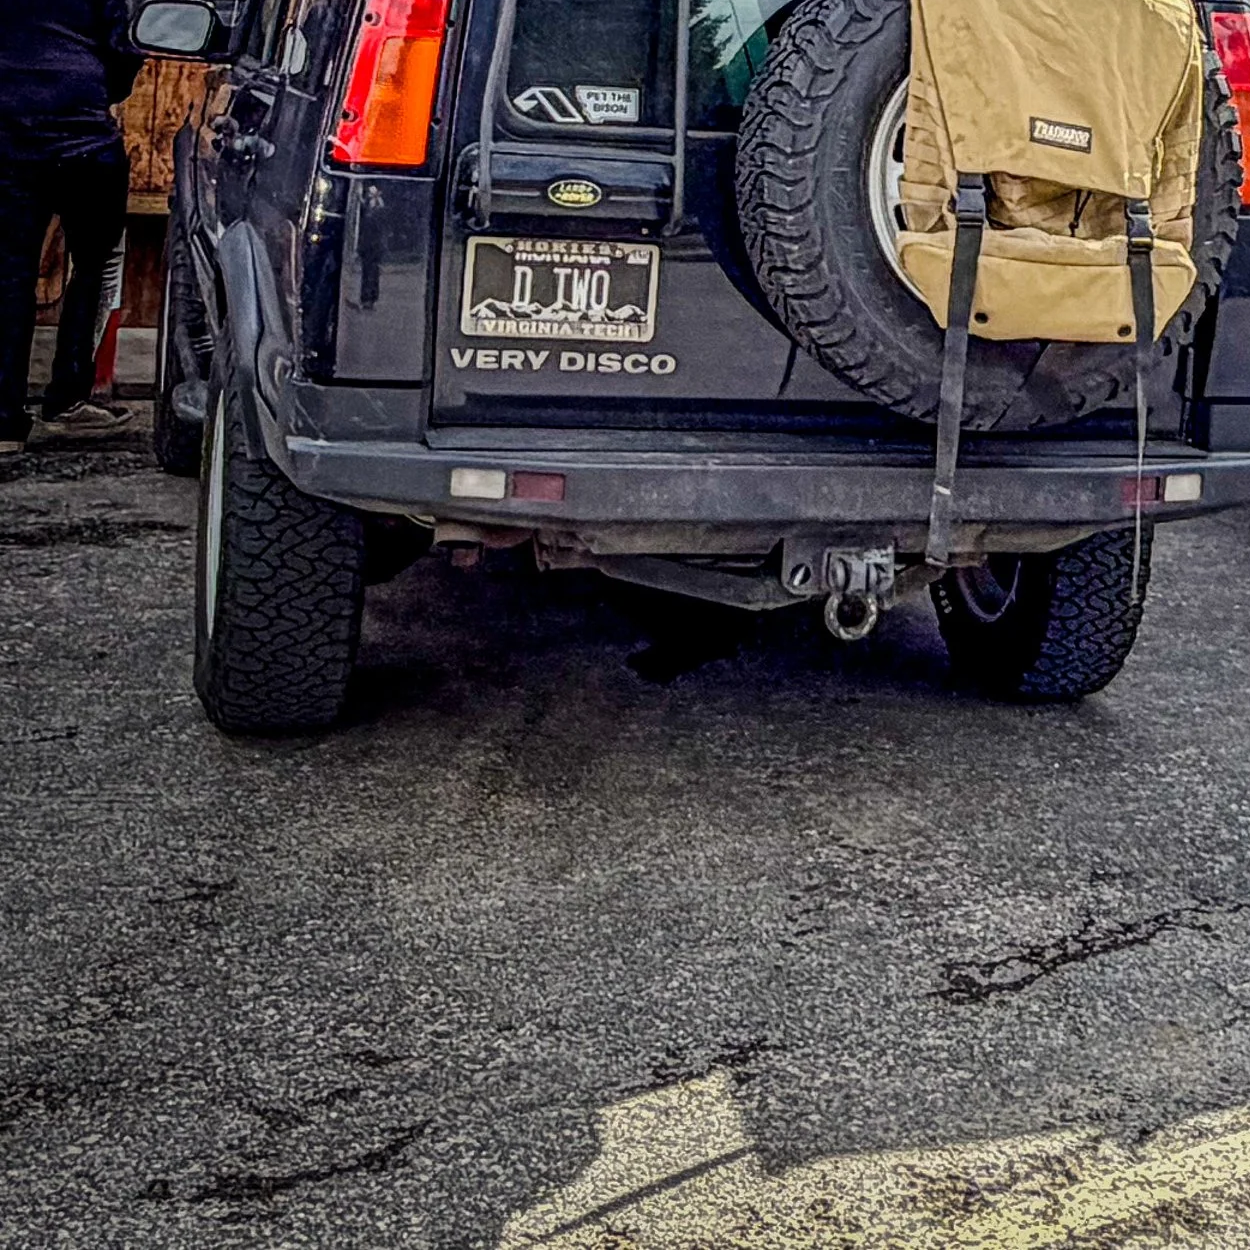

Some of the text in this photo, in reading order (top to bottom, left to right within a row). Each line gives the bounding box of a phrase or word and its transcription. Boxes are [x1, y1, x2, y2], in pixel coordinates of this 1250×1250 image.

[586, 91, 632, 102] PET THE
[593, 103, 628, 114] BISON
[513, 265, 611, 311] D TWO
[483, 318, 633, 338] VIRGINIA TECH
[450, 348, 678, 375] VERY DISCO
